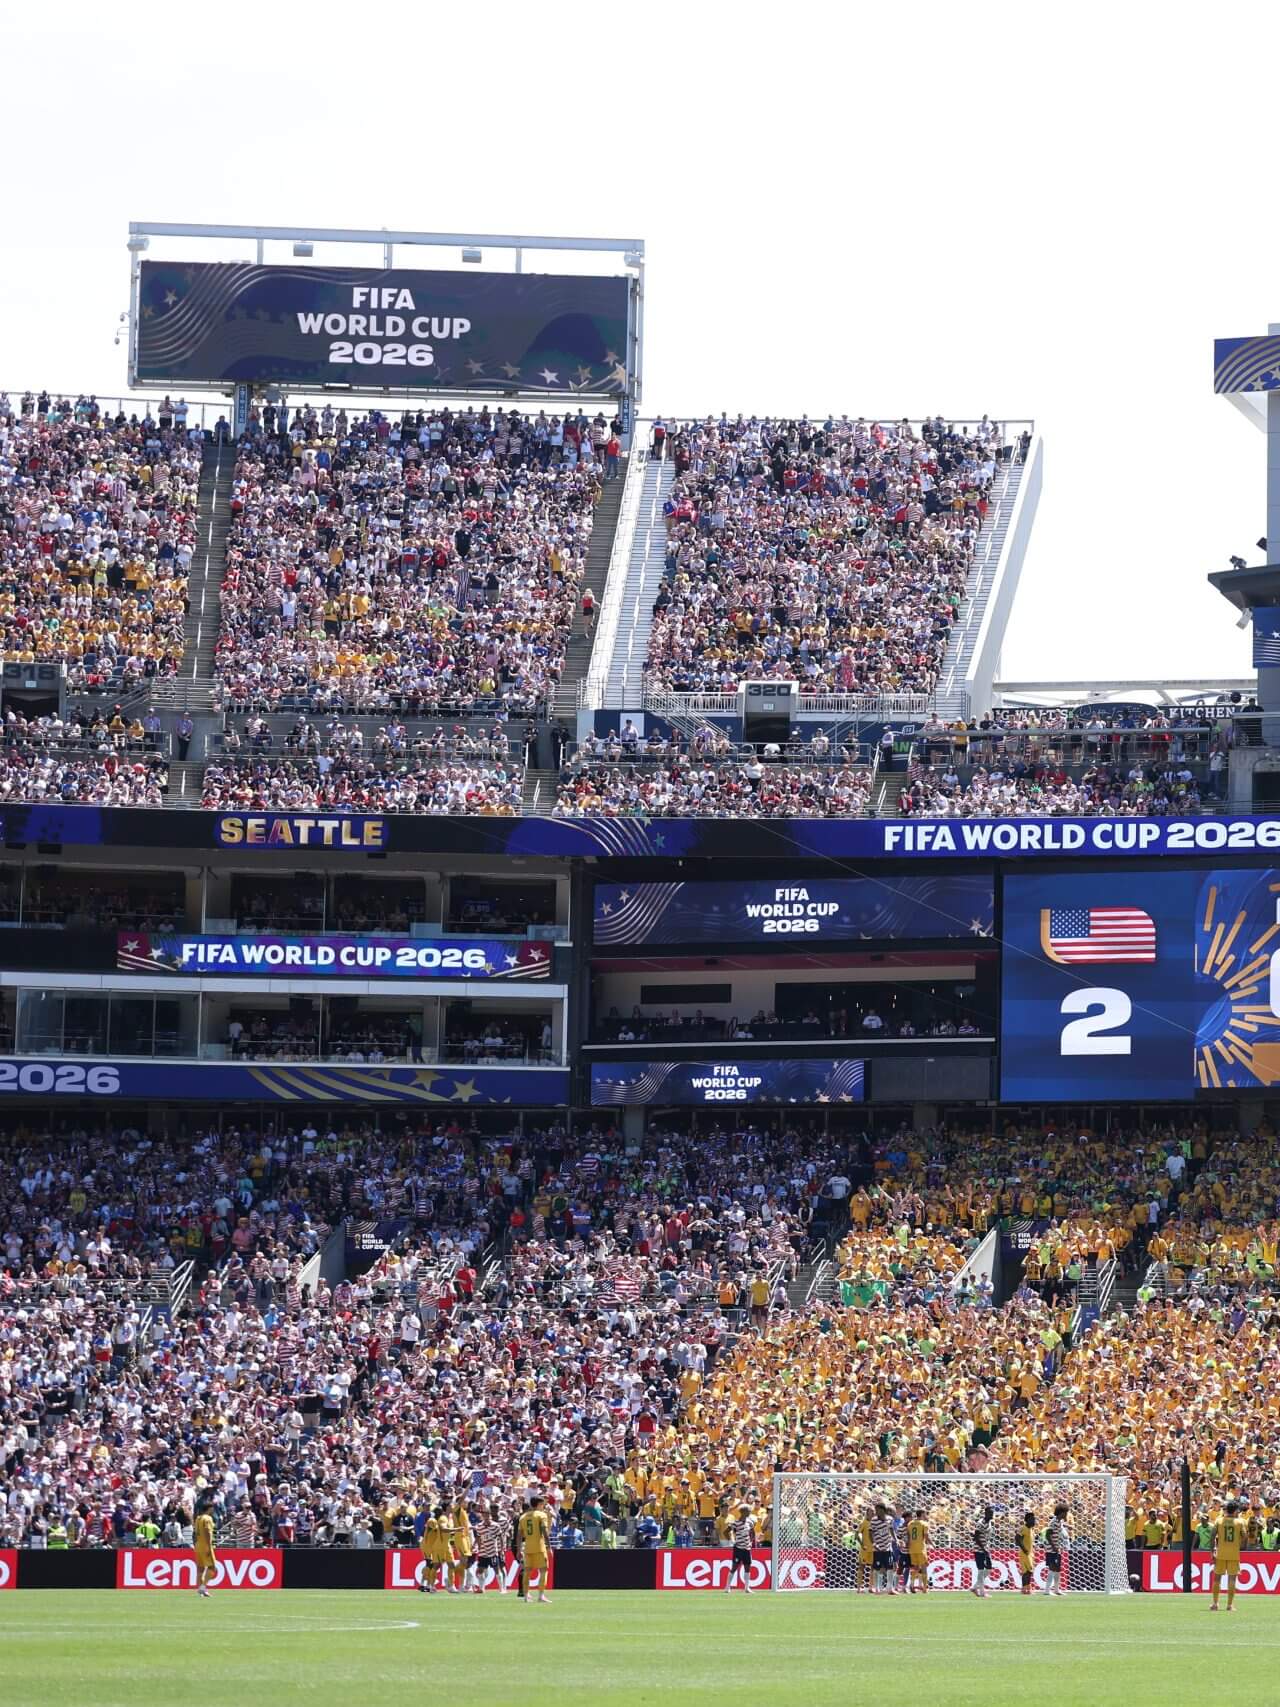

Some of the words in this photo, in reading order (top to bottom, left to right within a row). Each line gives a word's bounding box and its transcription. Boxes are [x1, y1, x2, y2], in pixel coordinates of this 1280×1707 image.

[352, 287, 416, 310] FIFA
[297, 312, 406, 337] WORLD
[411, 316, 471, 339] CUP
[328, 341, 434, 366] 2026
[748, 684, 791, 697] 320
[1168, 706, 1236, 719] KITCHEN
[220, 817, 384, 846] SEATTLE
[883, 824, 957, 851] FIFA
[962, 823, 1086, 850] WORLD
[1091, 822, 1161, 849] CUP
[775, 887, 810, 902] FIFA
[746, 903, 805, 918] WORLD
[806, 902, 840, 916] CUP
[762, 918, 820, 933] 2026
[182, 943, 237, 964] FIFA
[241, 944, 336, 966] WORLD
[340, 946, 392, 966] CUP
[395, 947, 487, 968] 2026
[1060, 987, 1132, 1056] 2
[0, 1062, 120, 1094] 2026
[713, 1065, 740, 1076] FIFA
[691, 1077, 736, 1089] WORLD
[737, 1077, 762, 1088] CUP
[704, 1089, 747, 1100] 2026
[526, 1519, 534, 1536] 5
[911, 1527, 918, 1540] 8
[1223, 1524, 1235, 1543] 13
[123, 1551, 275, 1587] Lenovo
[924, 1558, 1058, 1589] enovo
